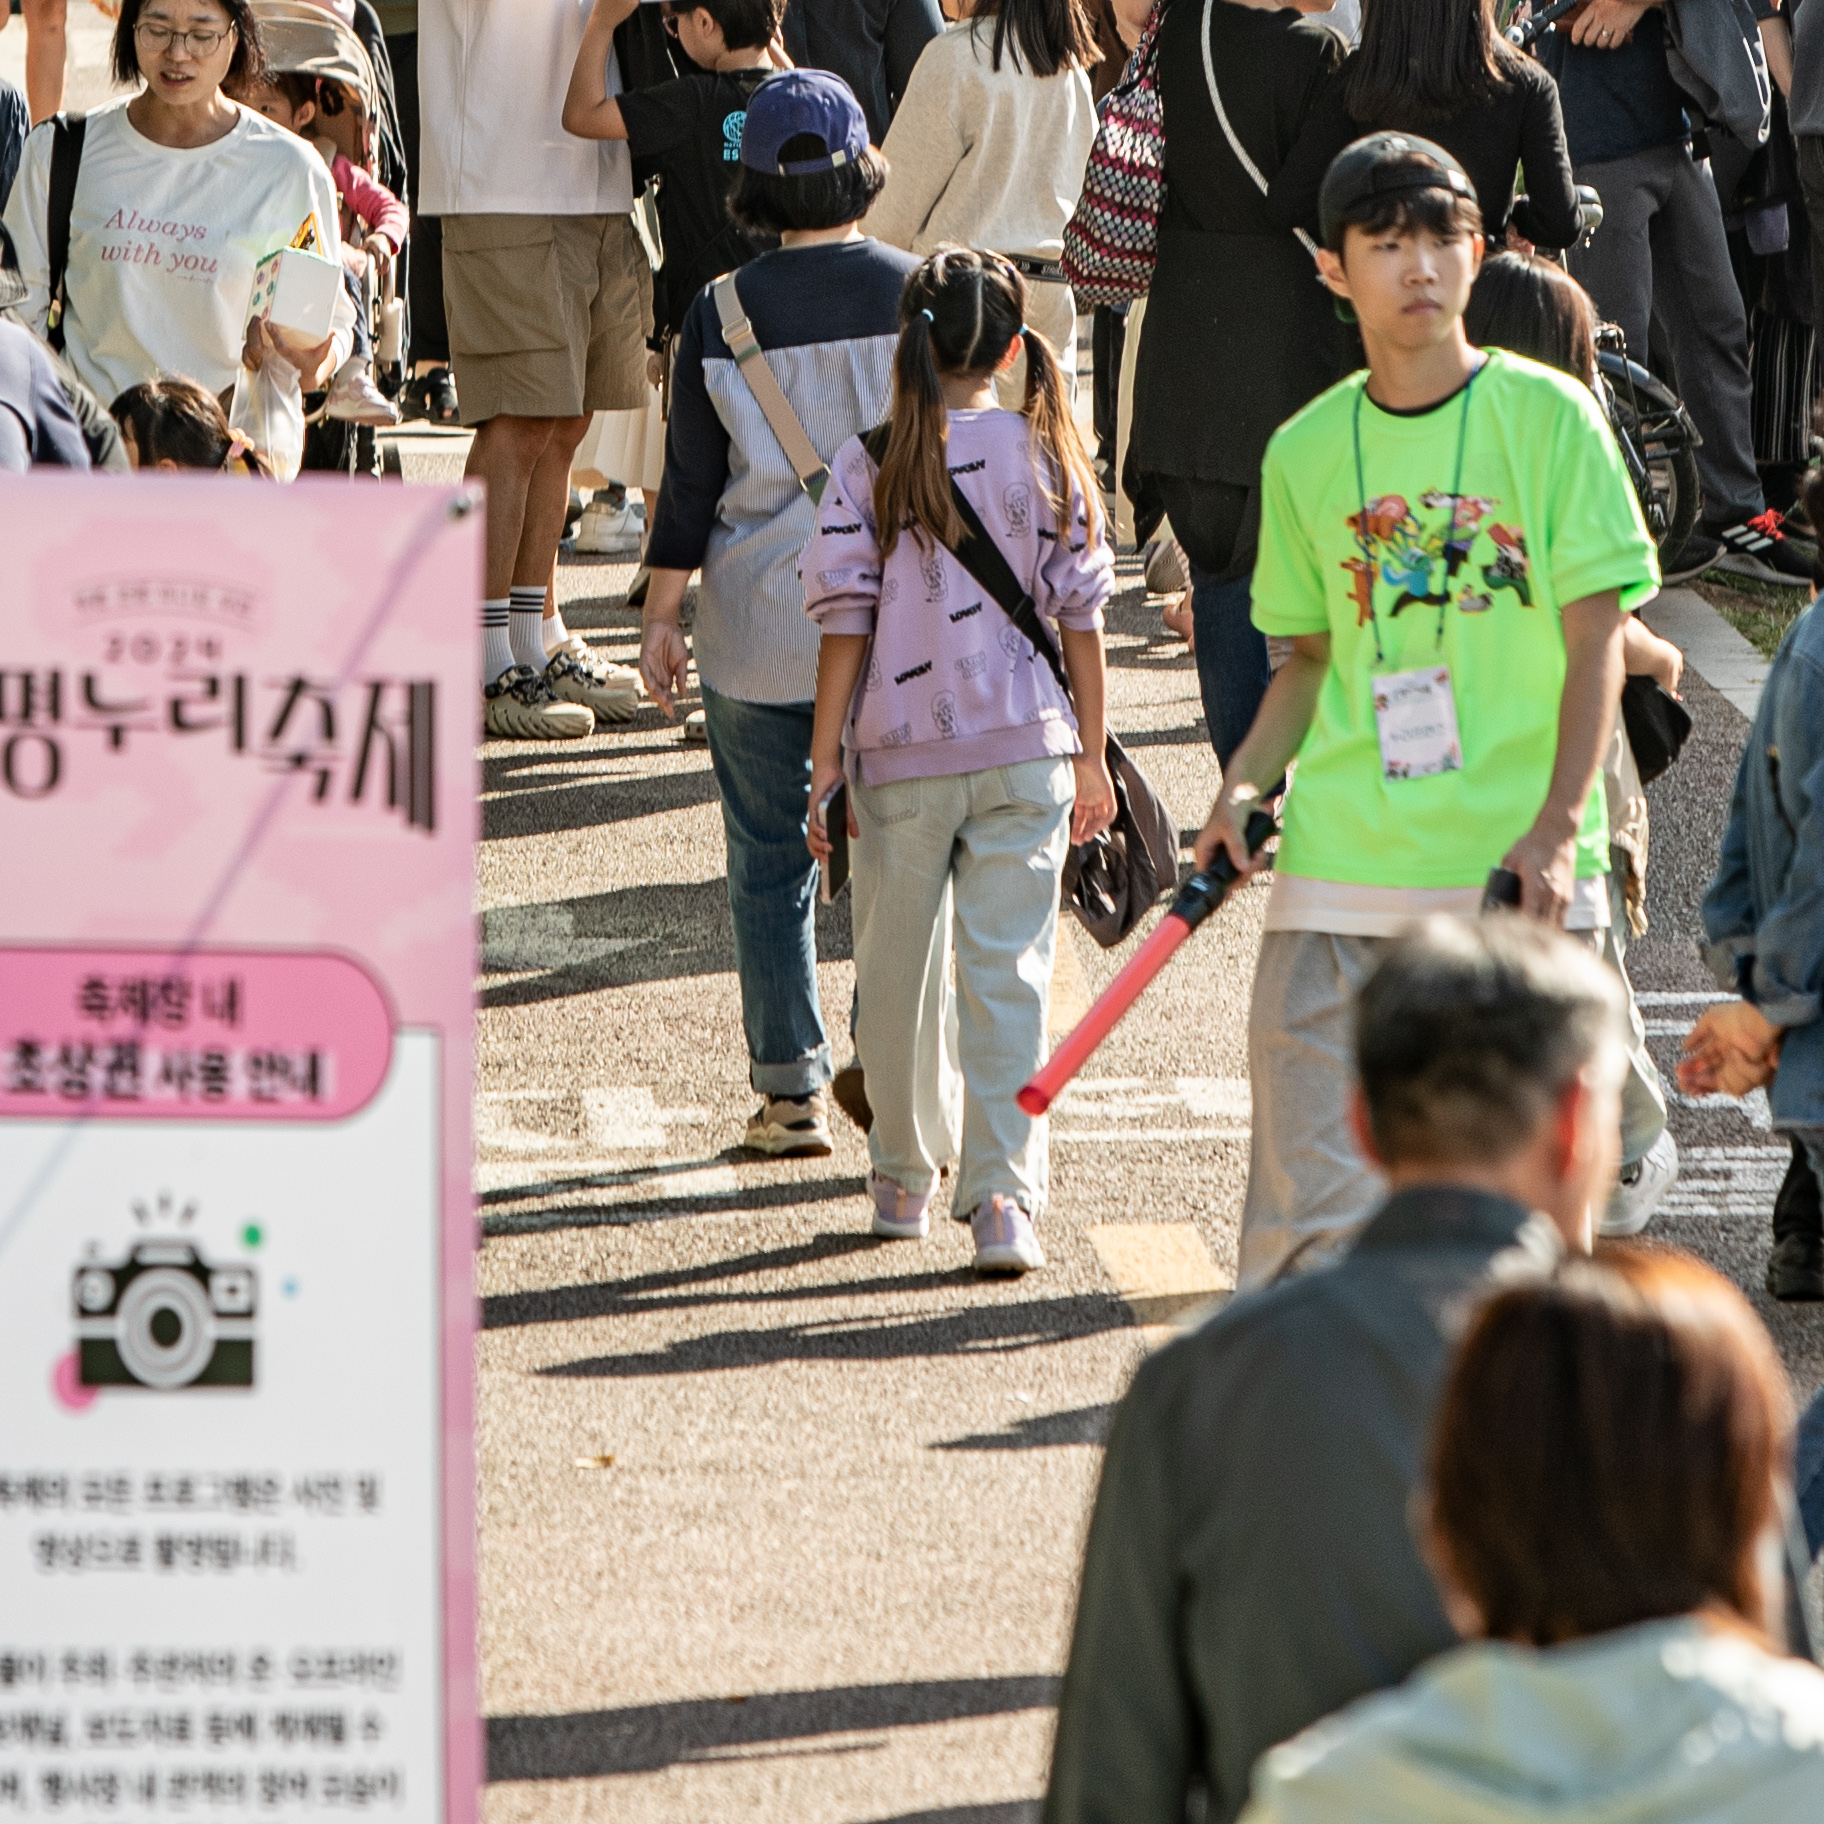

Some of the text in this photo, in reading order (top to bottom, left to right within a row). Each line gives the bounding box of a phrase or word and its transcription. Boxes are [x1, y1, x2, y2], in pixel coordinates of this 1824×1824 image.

[105, 207, 207, 242] Always
[101, 240, 218, 274] with you
[77, 976, 243, 1026] 축제장 내
[2, 1042, 144, 1100] 초상권
[245, 1048, 325, 1102] 안내
